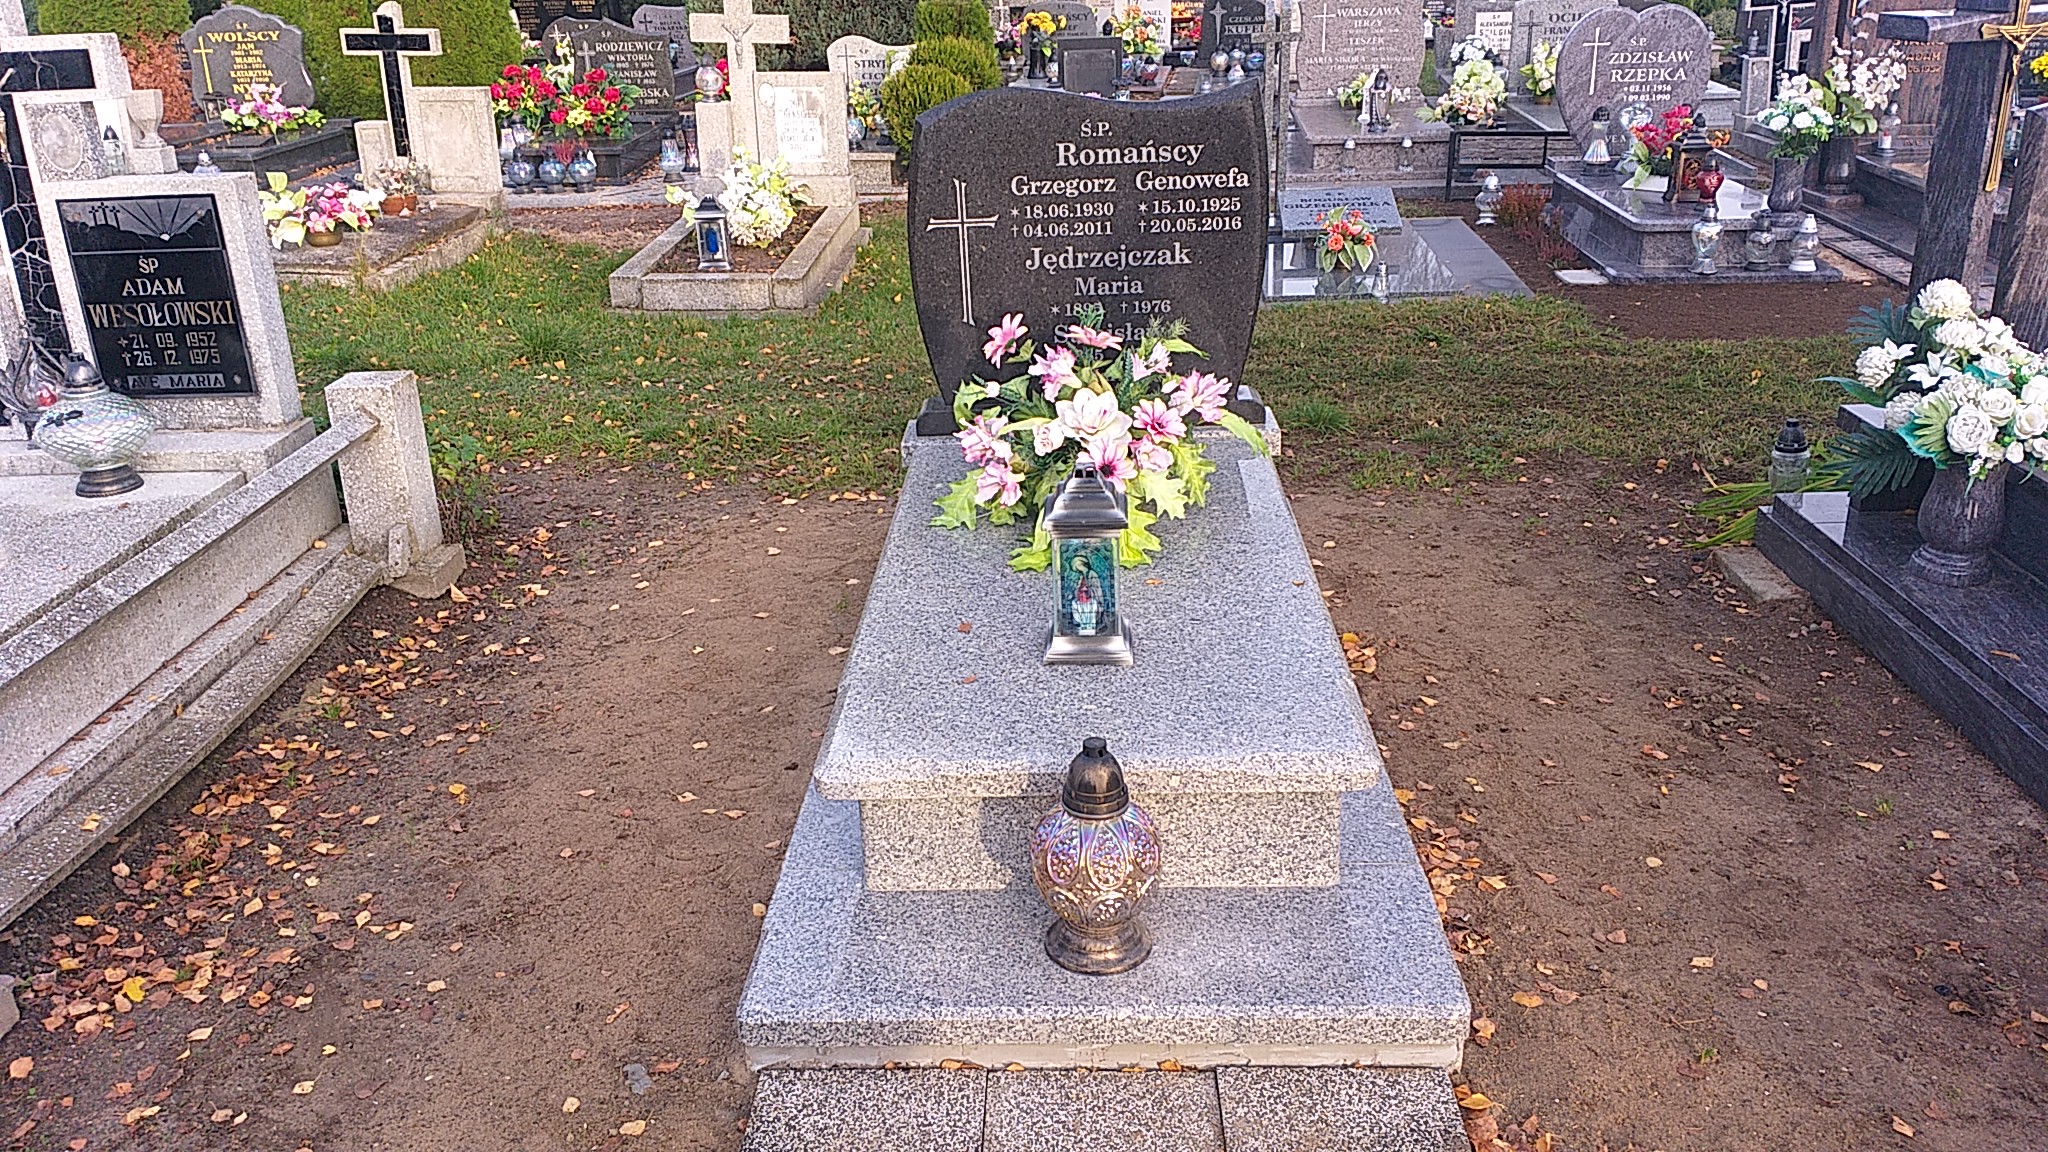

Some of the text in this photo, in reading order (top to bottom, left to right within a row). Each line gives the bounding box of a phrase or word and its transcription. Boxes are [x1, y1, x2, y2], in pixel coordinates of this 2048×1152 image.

[1337, 7, 1401, 17] WARSZAWA
[206, 30, 280, 43] WOLSCY
[595, 41, 664, 52] RODZIEWICZ
[607, 53, 655, 62] WIKTORIA
[1608, 50, 1693, 64] ZDZISŁAW
[1611, 67, 1687, 82] RZEPKA
[1080, 119, 1113, 138] Ś.P.
[1055, 140, 1205, 167] Romańscy
[1010, 167, 1251, 198] Grzegorz Genowefa
[1024, 197, 1242, 220] 18.06.1930 15.10.1925
[1022, 216, 1242, 238] 04.06.2011 20.05.2016
[1025, 242, 1193, 275] Jędrzejczak
[121, 277, 186, 297] ADAM
[1074, 275, 1144, 297] Maria
[87, 300, 237, 329] WESOŁOWSKI
[1132, 299, 1172, 314] 1976
[129, 331, 218, 350] 21. 09. 1952
[164, 351, 182, 366] 12.
[190, 349, 222, 365] 1975
[131, 375, 225, 390] AVE MARIA
